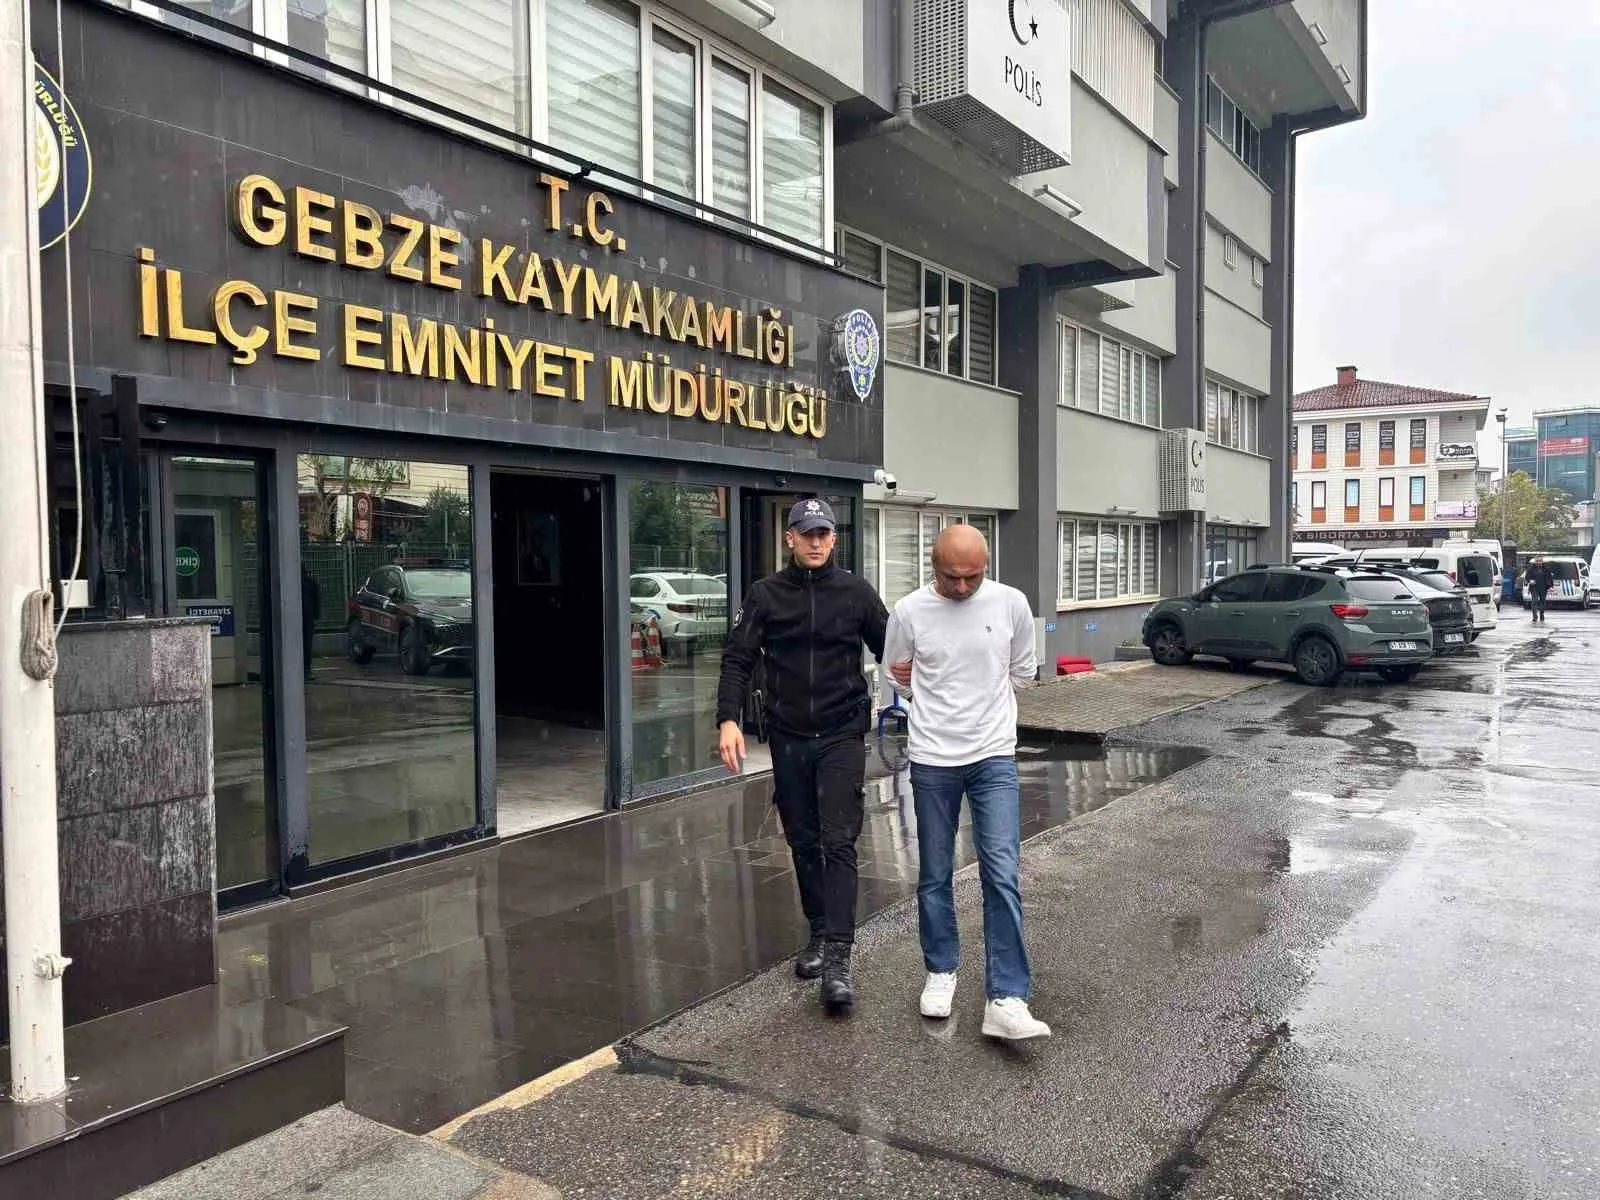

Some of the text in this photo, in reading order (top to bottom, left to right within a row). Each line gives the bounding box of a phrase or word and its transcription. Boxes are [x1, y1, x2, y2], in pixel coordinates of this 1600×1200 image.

[236, 174, 793, 369] GEBZE KAYMAKAMLIĞI
[537, 173, 626, 252] T.C.
[137, 247, 321, 365] İLÇE
[342, 304, 594, 401] EMNİYET
[608, 351, 827, 439] MÜDÜRLÜĞÜ
